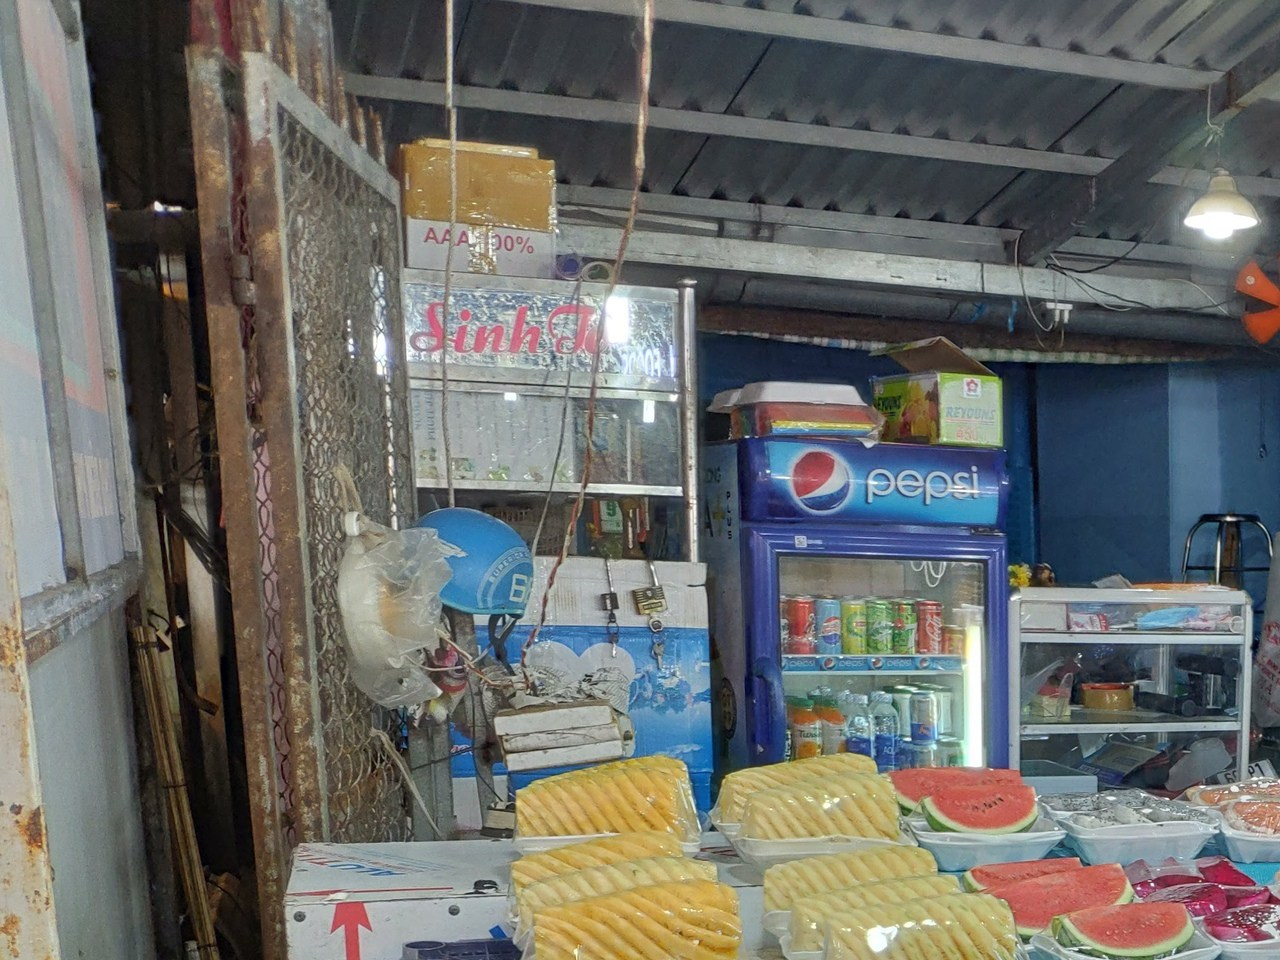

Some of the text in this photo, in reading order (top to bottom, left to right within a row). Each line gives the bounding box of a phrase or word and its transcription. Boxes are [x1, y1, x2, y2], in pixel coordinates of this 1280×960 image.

[483, 233, 534, 254] 00%
[410, 301, 542, 355] Sinh
[866, 465, 979, 505] pepsi
